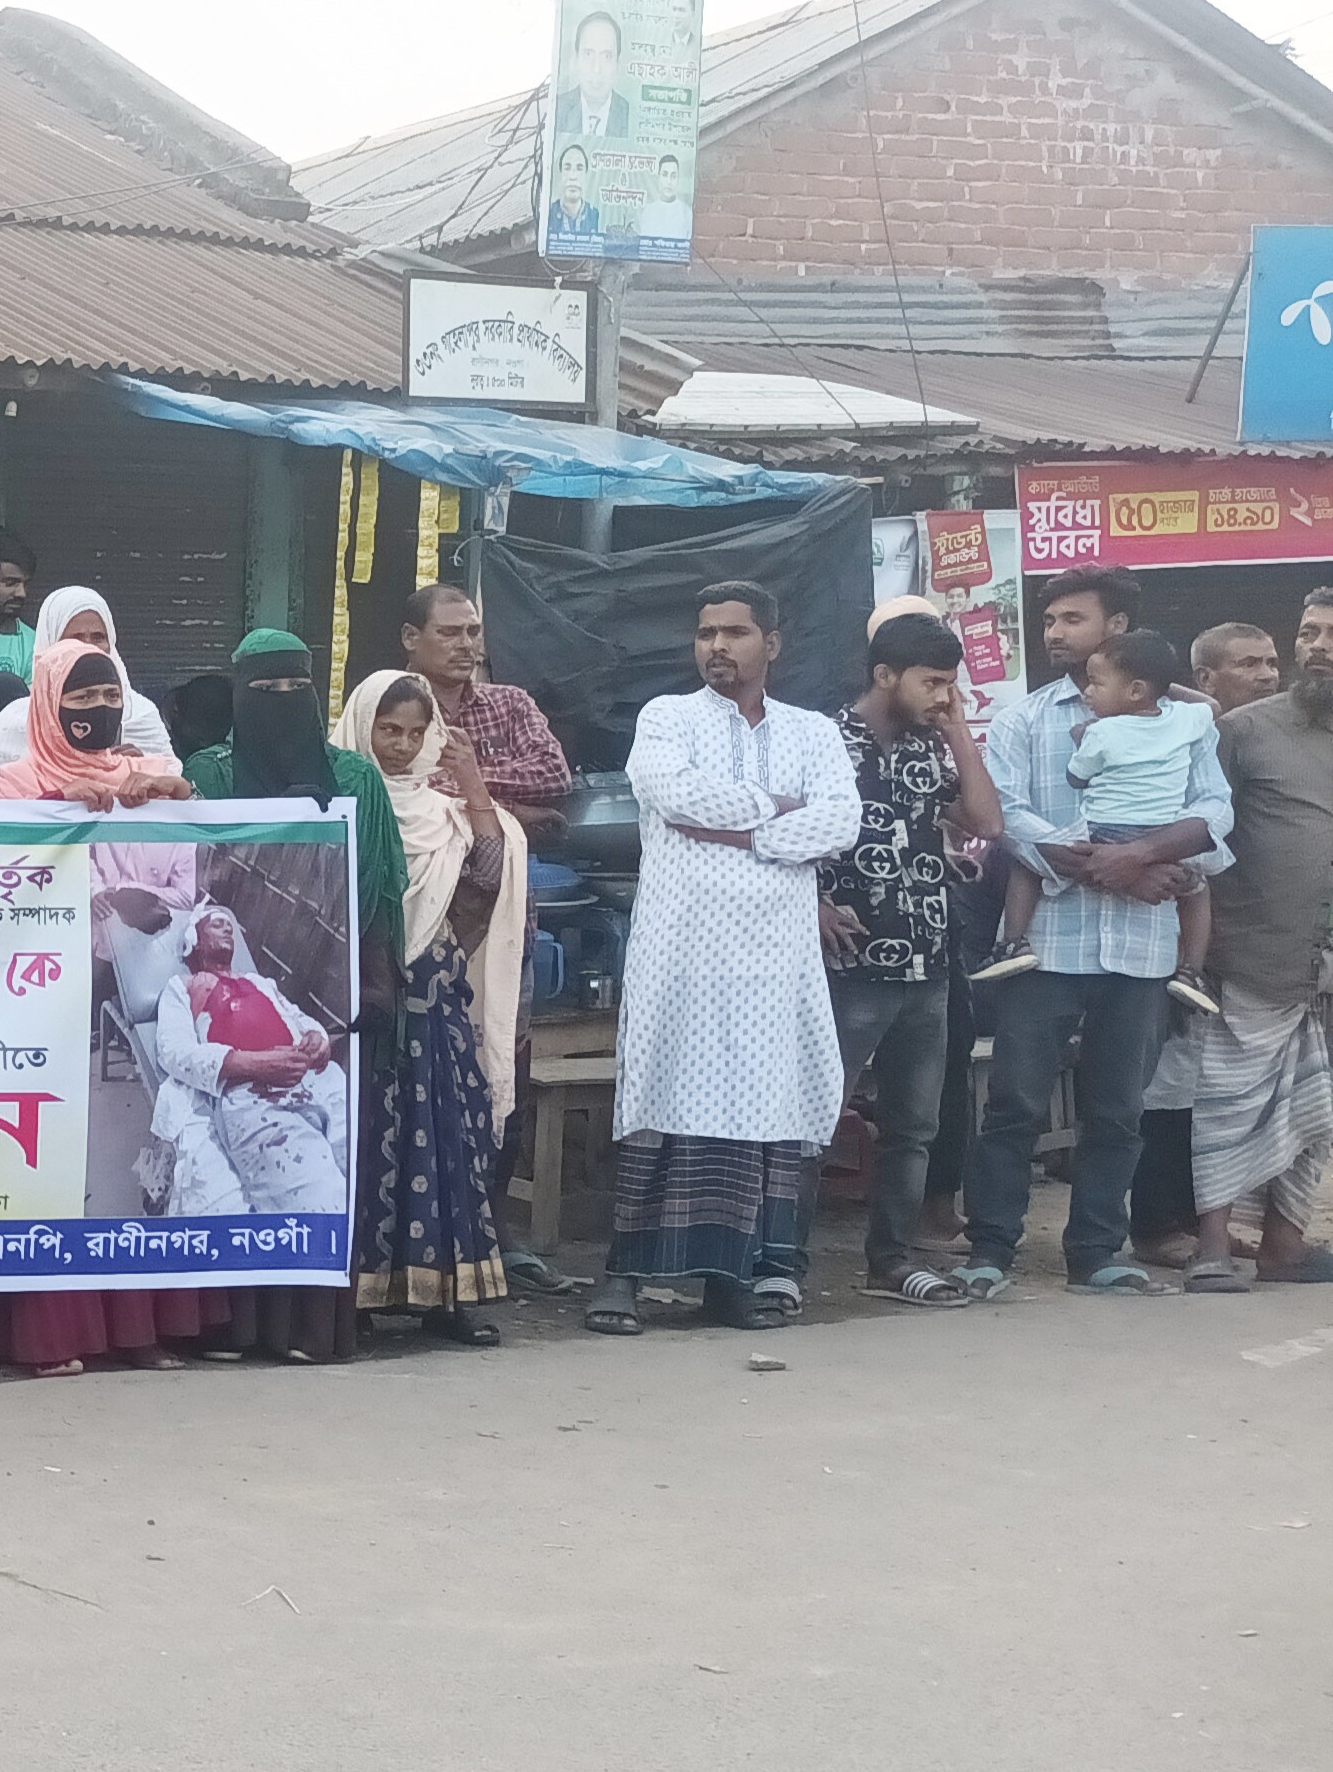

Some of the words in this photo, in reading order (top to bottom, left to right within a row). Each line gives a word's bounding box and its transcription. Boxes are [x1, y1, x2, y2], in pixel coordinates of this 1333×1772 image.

[1027, 491, 1101, 533] সুবিধা
[1027, 530, 1101, 559] ডাবল
[10, 905, 76, 928] সম্পাদক
[5, 950, 62, 997] কে
[83, 1223, 219, 1260] রাণীনগর,
[230, 1218, 309, 1253] নওগাঁ
